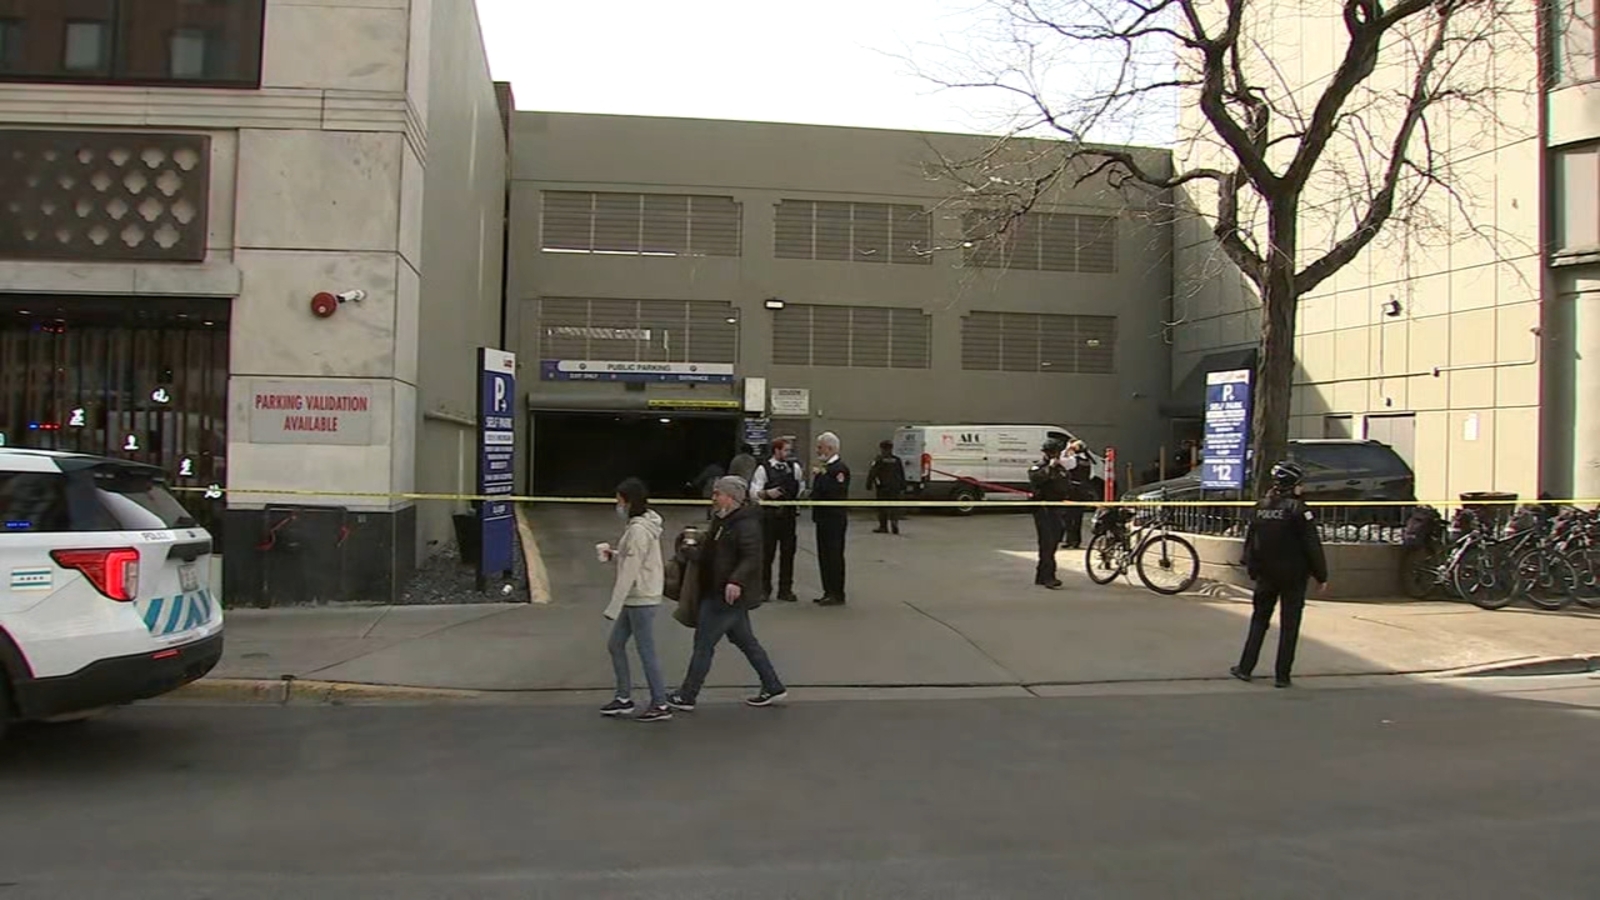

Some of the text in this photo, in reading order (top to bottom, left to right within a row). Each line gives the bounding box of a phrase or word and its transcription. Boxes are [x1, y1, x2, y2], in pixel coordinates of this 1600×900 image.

[607, 363, 671, 372] PUBLIC PARKING
[255, 394, 368, 411] PARKING VALIDATION
[283, 416, 338, 432] AVAILABLE
[1212, 464, 1232, 481] $12
[1256, 509, 1284, 520] POLICE
[141, 531, 170, 541] POLICE
